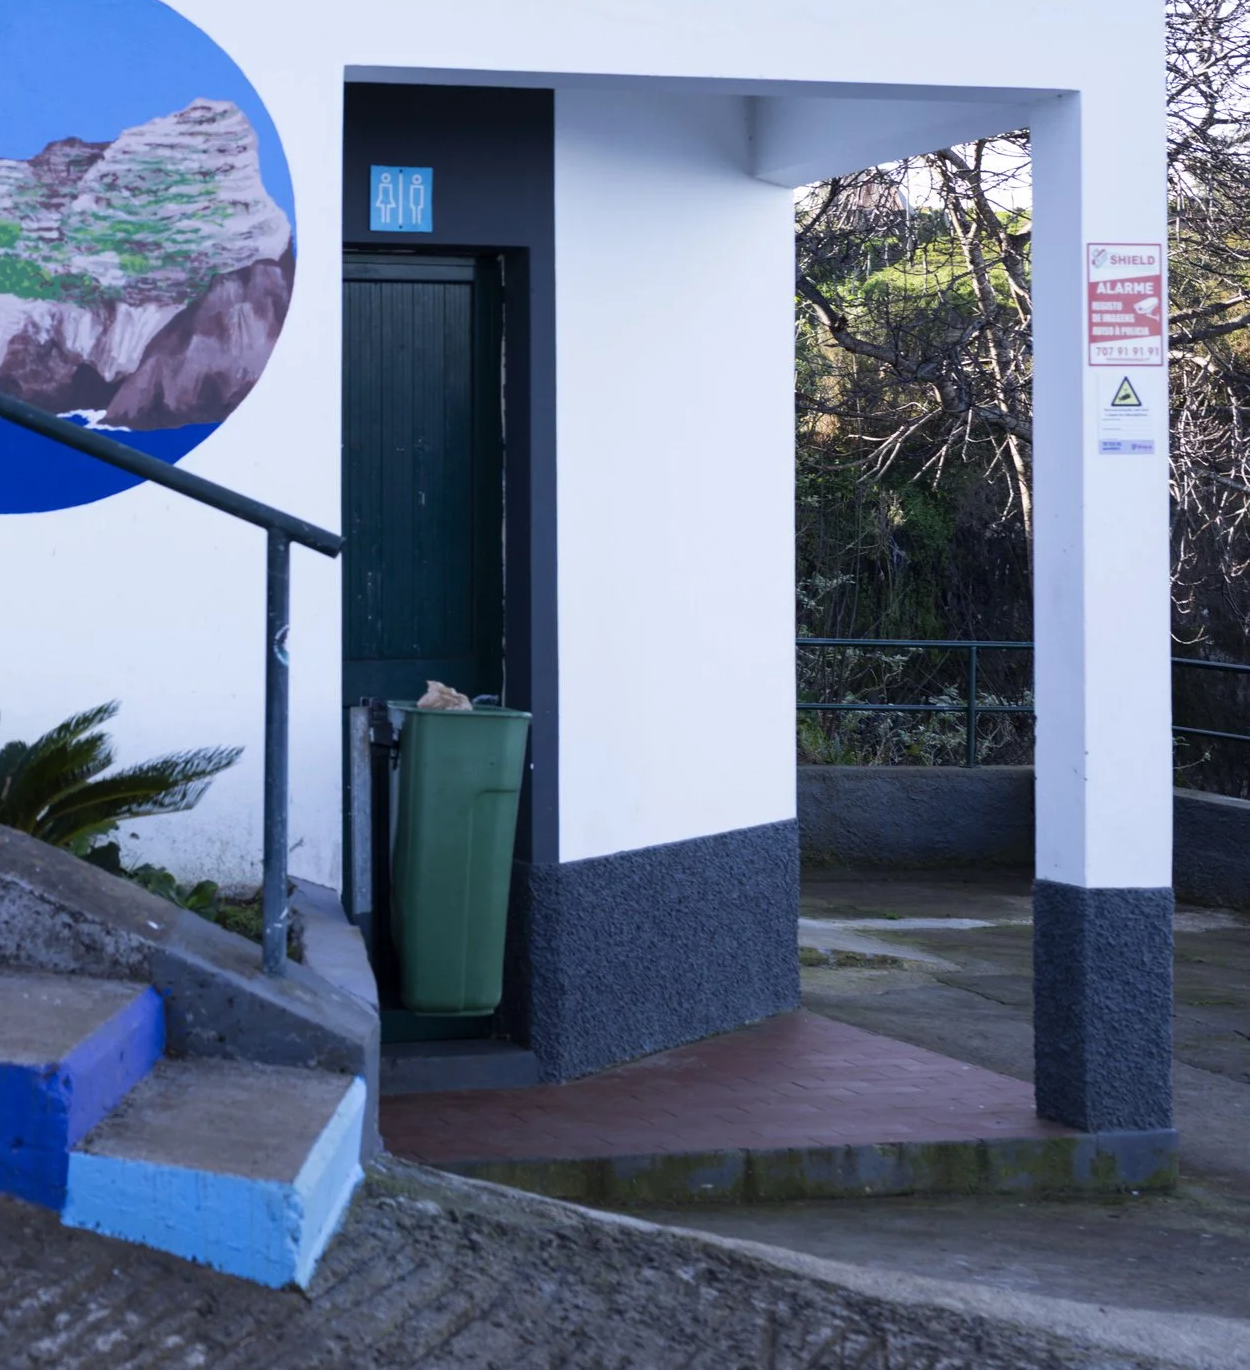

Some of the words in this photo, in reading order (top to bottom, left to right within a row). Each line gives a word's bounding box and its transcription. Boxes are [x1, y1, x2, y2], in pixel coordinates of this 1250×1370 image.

[1110, 255, 1156, 266] SHIELD
[1096, 282, 1154, 295] ALARME
[1096, 346, 1114, 357] 707
[1117, 346, 1129, 356] 91
[1132, 346, 1144, 356] 91
[1147, 346, 1160, 356] 91
